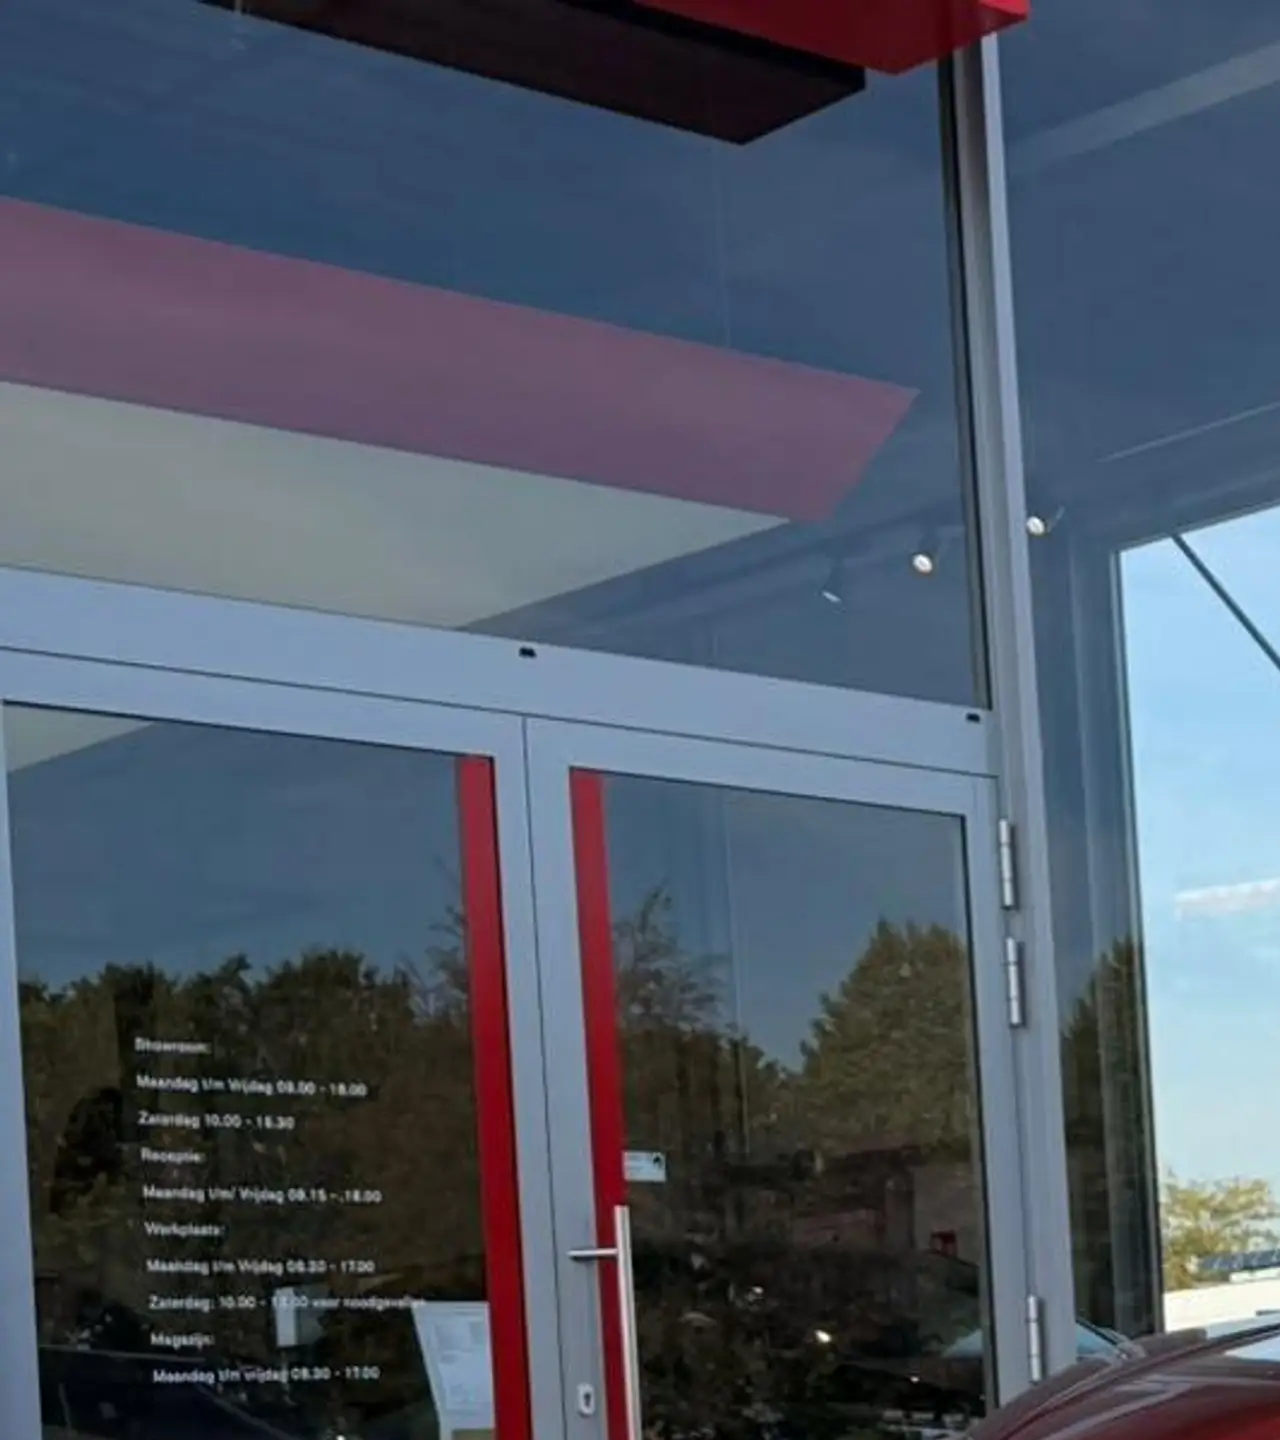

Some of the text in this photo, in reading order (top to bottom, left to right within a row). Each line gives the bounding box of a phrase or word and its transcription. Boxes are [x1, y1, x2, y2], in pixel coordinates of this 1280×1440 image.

[136, 1074, 198, 1093] Maandag
[138, 1110, 200, 1129] Zaterdag
[142, 1184, 205, 1203] Maandag
[239, 1187, 284, 1205] Vrijdag
[147, 1259, 209, 1276] Maandag
[238, 1260, 284, 1277] Vrijdag
[153, 1368, 215, 1384] Maandag
